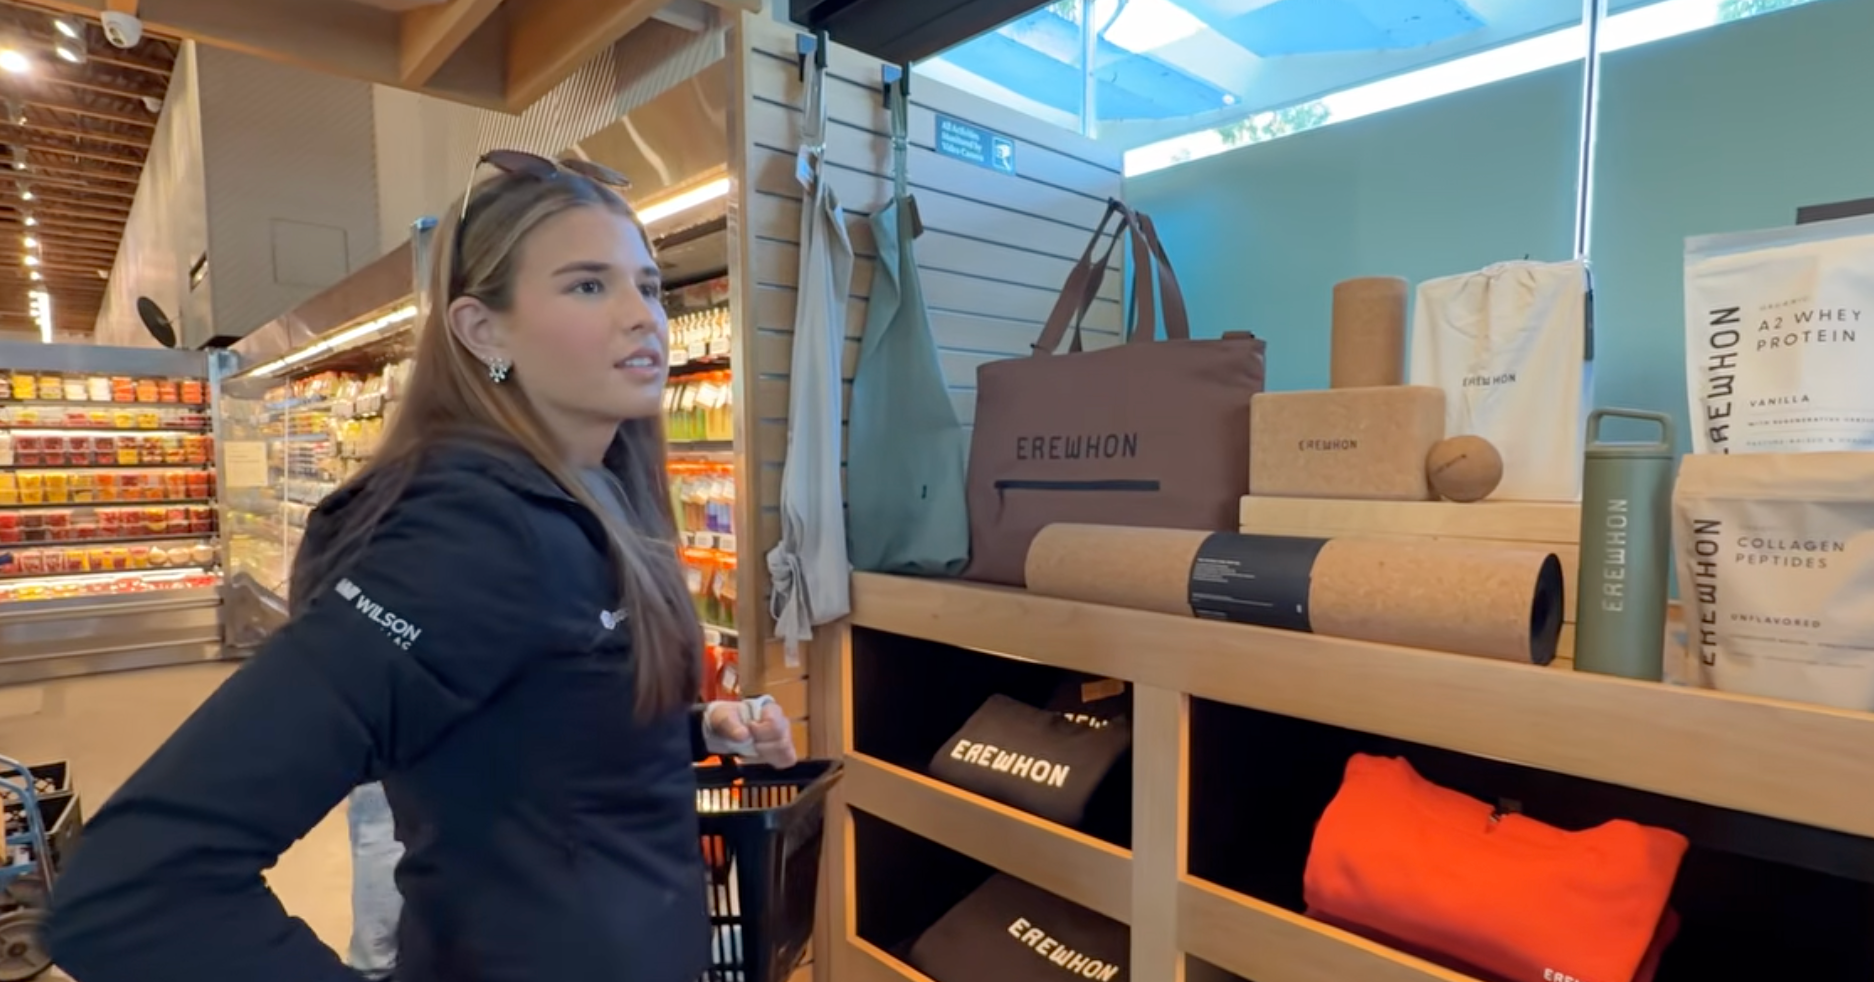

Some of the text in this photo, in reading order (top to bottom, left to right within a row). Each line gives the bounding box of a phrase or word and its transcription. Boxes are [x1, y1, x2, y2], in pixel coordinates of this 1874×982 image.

[1757, 308, 1862, 332] A2 WHEY
[1756, 329, 1857, 352] PROTEIN
[1706, 306, 1741, 454] REWHON
[1750, 395, 1811, 408] VANILLA
[1016, 432, 1138, 460] EREWHON
[1298, 439, 1358, 452] EREWHON
[1601, 499, 1628, 612] EREWHON
[1737, 536, 1846, 553] COLLAGEN
[1735, 553, 1828, 569] PEPTIDES
[1693, 518, 1722, 667] EREWHON
[356, 594, 422, 641] WILSON
[1730, 613, 1821, 629] UNFLAVORED
[951, 739, 1071, 788] EREWHON
[1007, 917, 1120, 982] EREWHON
[1543, 968, 1580, 982] ERE
